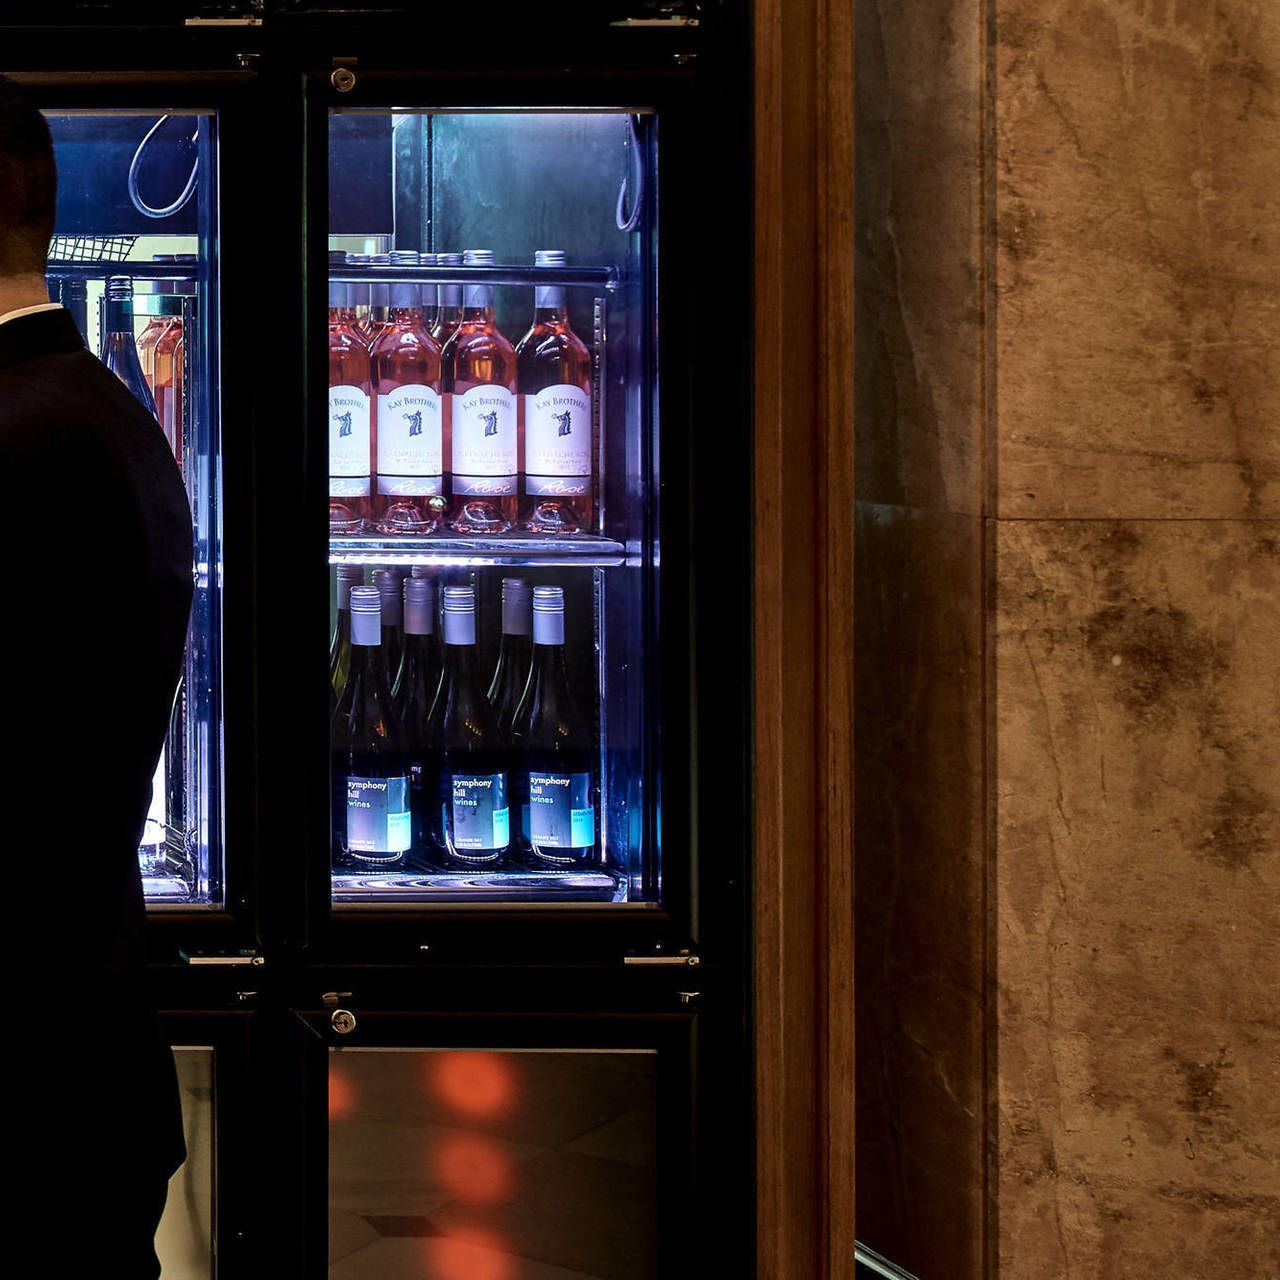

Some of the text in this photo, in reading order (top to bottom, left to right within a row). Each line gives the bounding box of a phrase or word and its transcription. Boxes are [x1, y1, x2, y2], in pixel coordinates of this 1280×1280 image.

[347, 780, 387, 791] symphony
[453, 778, 493, 789] symphony
[530, 776, 571, 787] symphony
[347, 789, 360, 799] hill
[453, 787, 466, 798] hill
[530, 785, 543, 795] hill
[347, 799, 371, 809] wines
[454, 798, 478, 807] wines
[531, 795, 554, 804] wines
